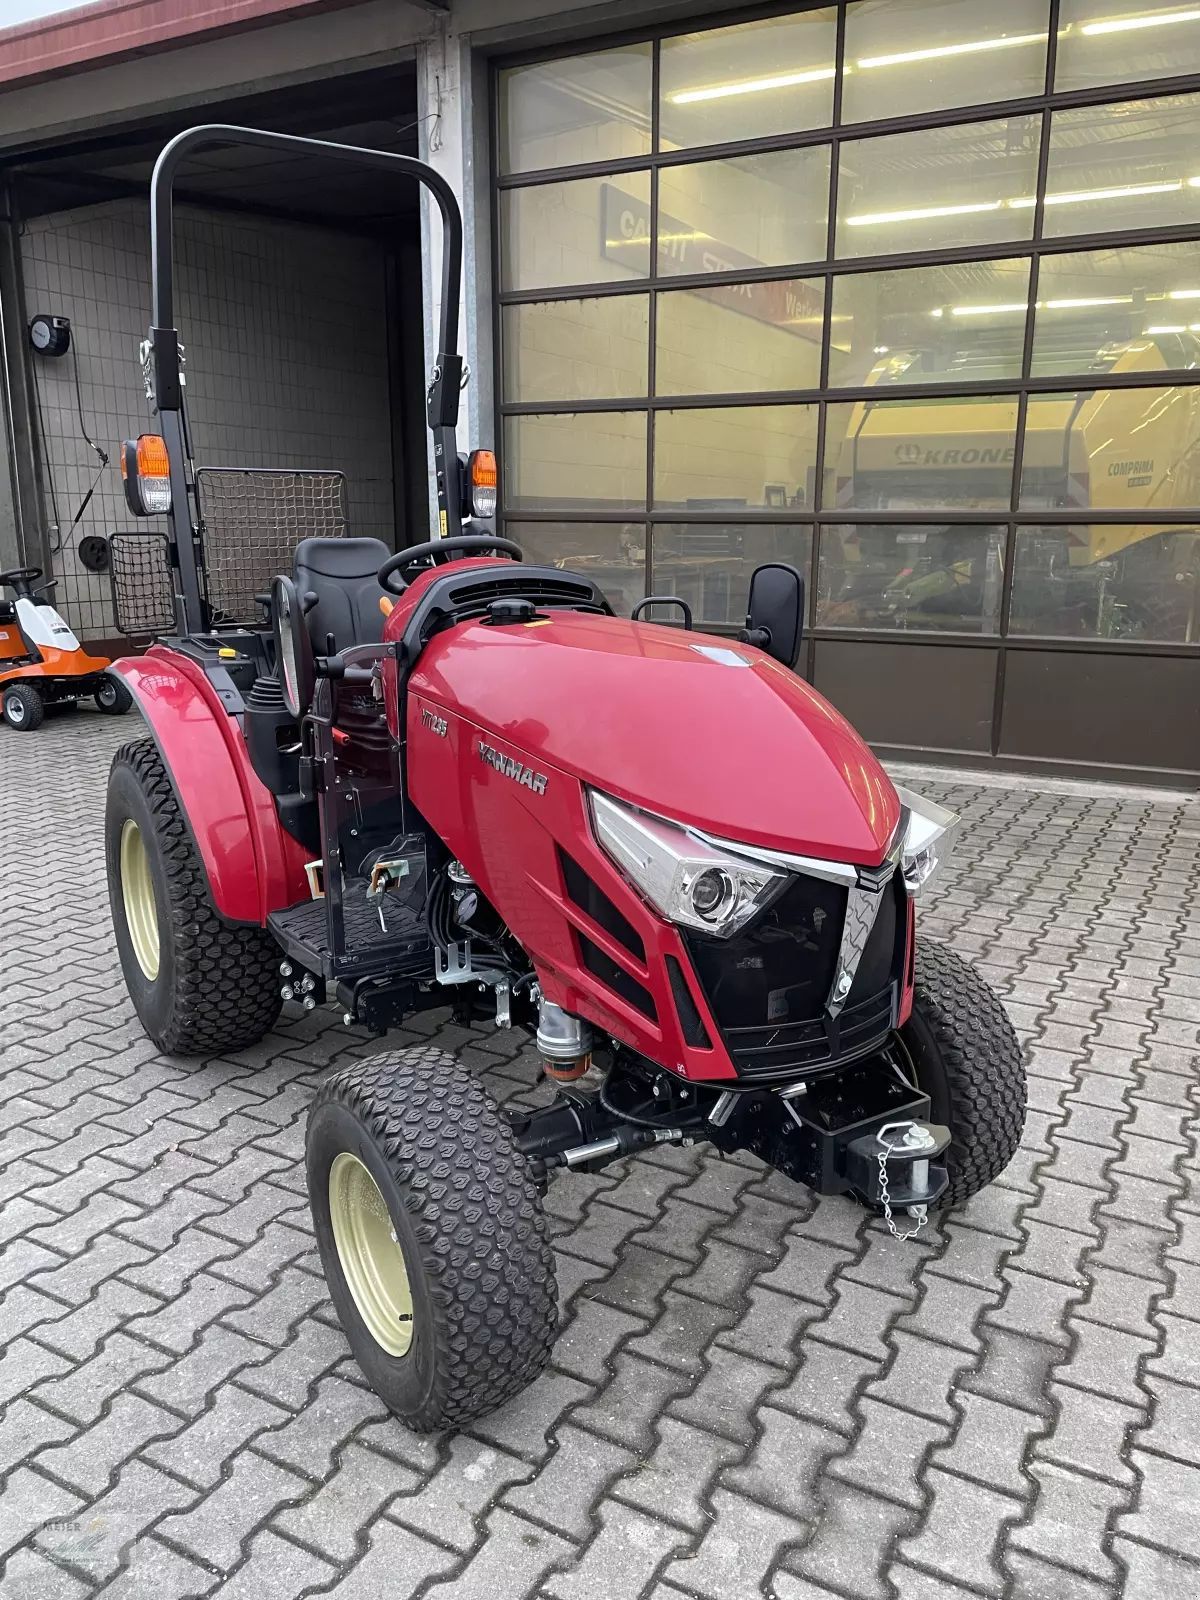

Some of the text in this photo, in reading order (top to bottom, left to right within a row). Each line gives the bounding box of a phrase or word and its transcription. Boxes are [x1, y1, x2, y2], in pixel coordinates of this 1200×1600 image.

[923, 447, 1015, 465] KRONE
[1108, 459, 1154, 477] COMPRIMA
[422, 708, 448, 738] YT235
[478, 740, 549, 796] YANMAR
